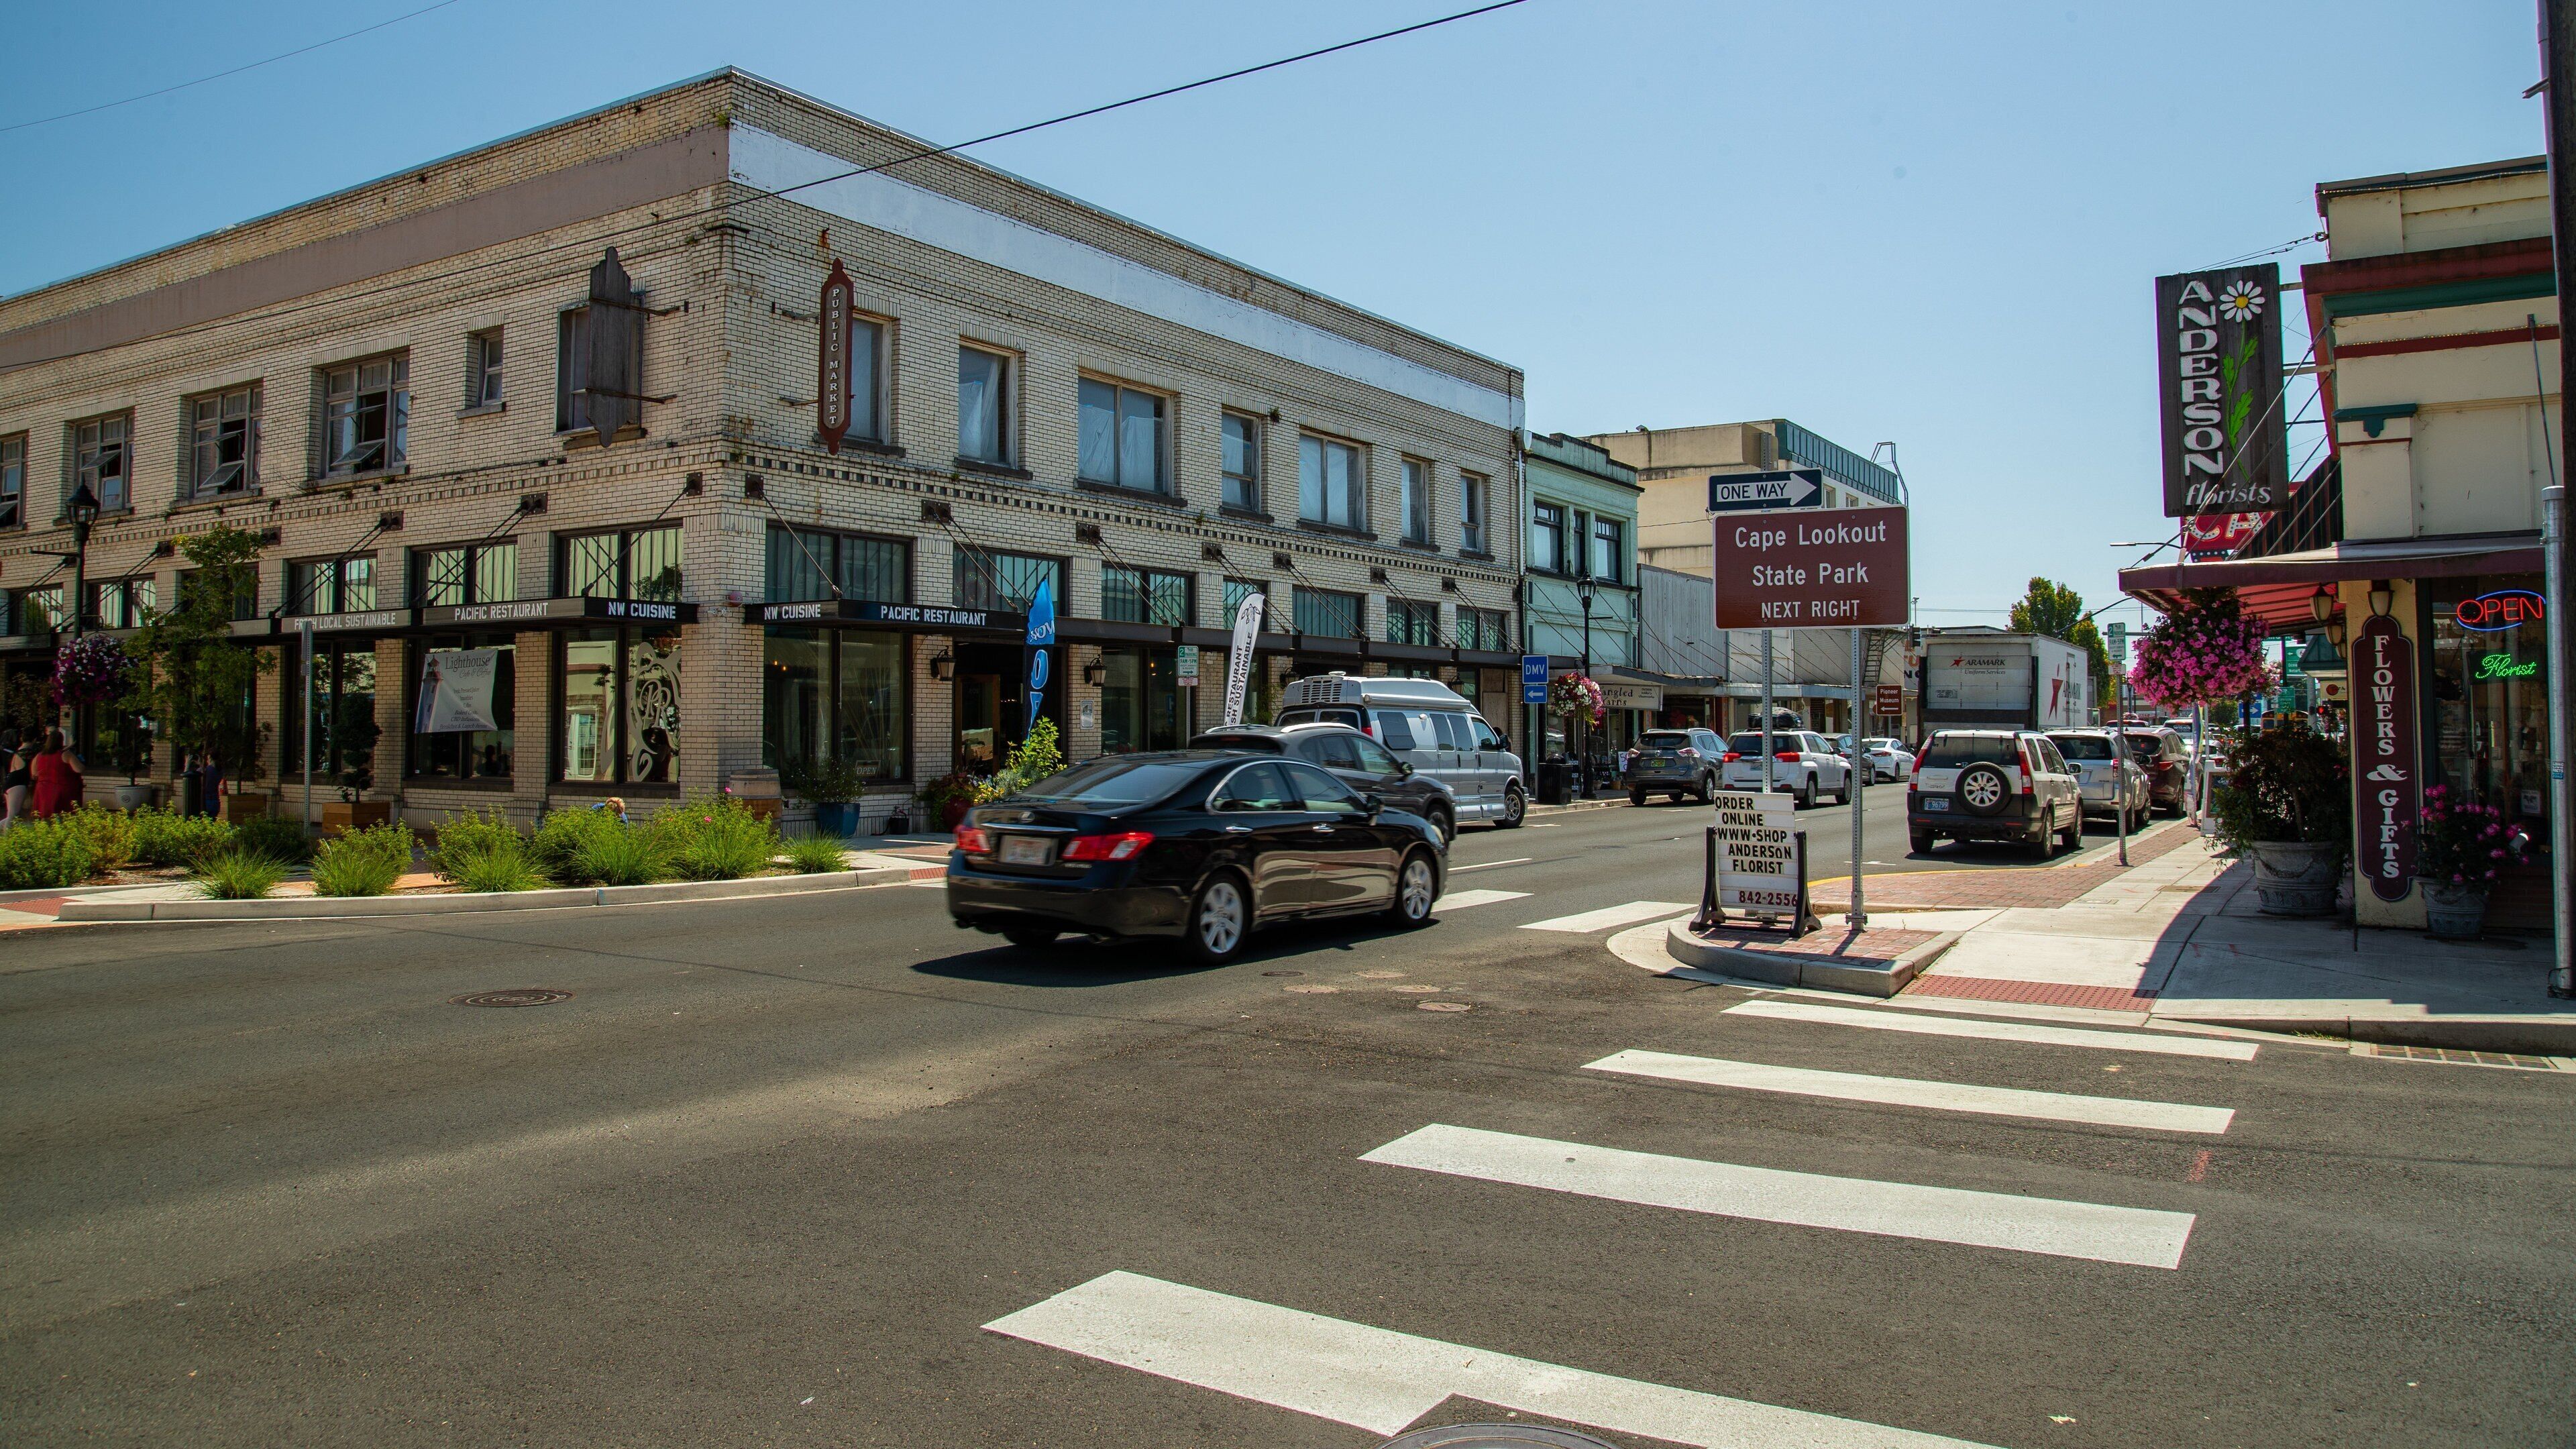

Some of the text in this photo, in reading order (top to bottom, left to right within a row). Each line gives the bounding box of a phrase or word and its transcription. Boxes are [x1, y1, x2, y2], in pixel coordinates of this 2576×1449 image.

[829, 288, 839, 424] PUBLIC MARKET
[2178, 280, 2224, 477] ANDERSON
[1721, 482, 1788, 500] ONE WAY
[2185, 482, 2272, 507] florists
[1735, 521, 1886, 552] Cape Lookout
[1752, 562, 1869, 587] State Park
[455, 602, 549, 621] PACIFIC RESTAURANT
[608, 602, 676, 619] NW CUISINE
[765, 604, 821, 621] NW CUISINE
[881, 605, 987, 626] PACIFIC RESTAURANT
[1761, 600, 1860, 619] NEXT RIGHT
[2456, 596, 2544, 623] OPEN
[294, 612, 396, 631] FRH LOCAL SUSTAINABLE
[1179, 648, 1185, 656] 2
[445, 655, 490, 673] Lighthouse
[1234, 632, 1253, 706] SUSTAINABLE
[1525, 664, 1546, 675] DMV
[2475, 654, 2538, 679] Florist
[1226, 645, 1243, 718] RESTAURANT
[1602, 687, 1633, 699] angled
[2366, 635, 2408, 879] FLOWERS & GIFTS
[857, 767, 877, 775] OPEN
[1715, 796, 1754, 810] ORDER
[1721, 812, 1764, 826] ONLINE
[1728, 843, 1792, 859] ANDERSON
[1733, 859, 1783, 873] FLORIST
[1739, 890, 1798, 906] 842-2556
